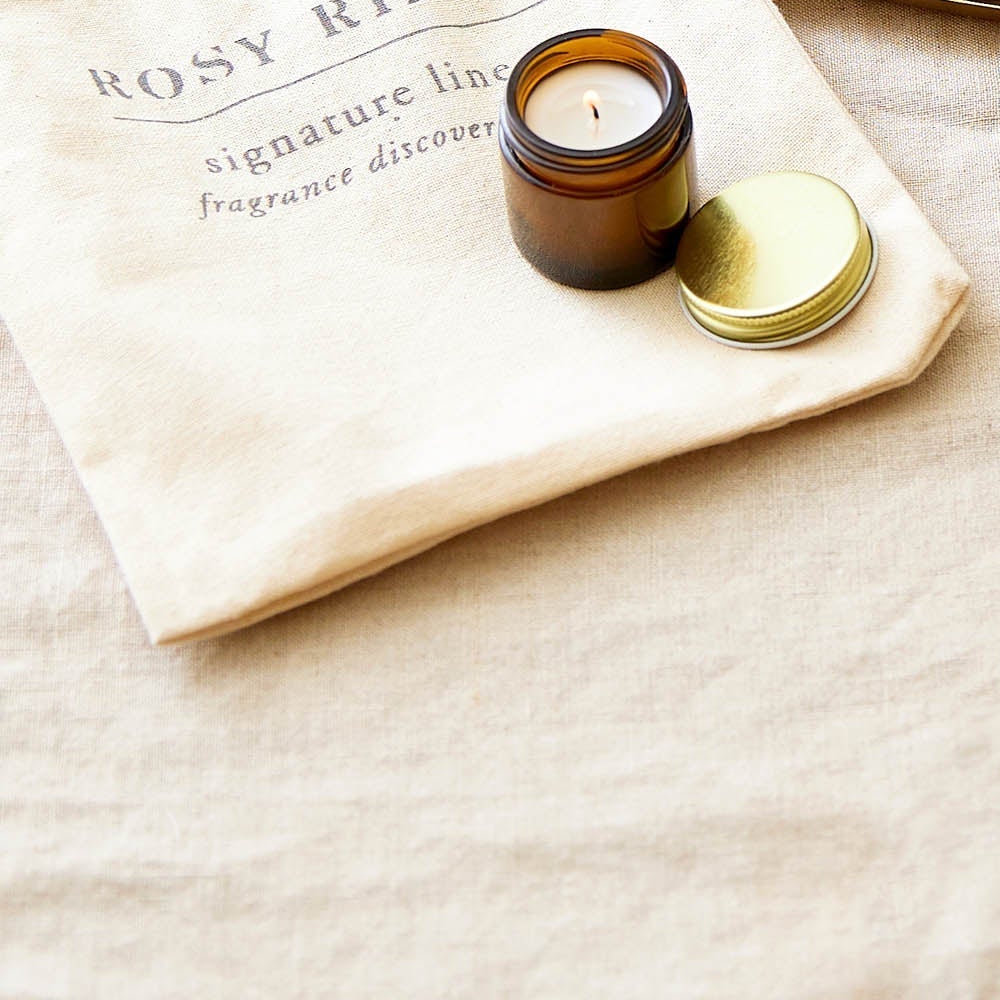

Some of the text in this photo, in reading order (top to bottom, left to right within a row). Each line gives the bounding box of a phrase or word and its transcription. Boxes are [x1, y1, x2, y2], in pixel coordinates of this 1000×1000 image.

[88, 29, 276, 101] ROSY
[205, 60, 510, 175] signature line
[198, 121, 496, 220] fragrance discover
